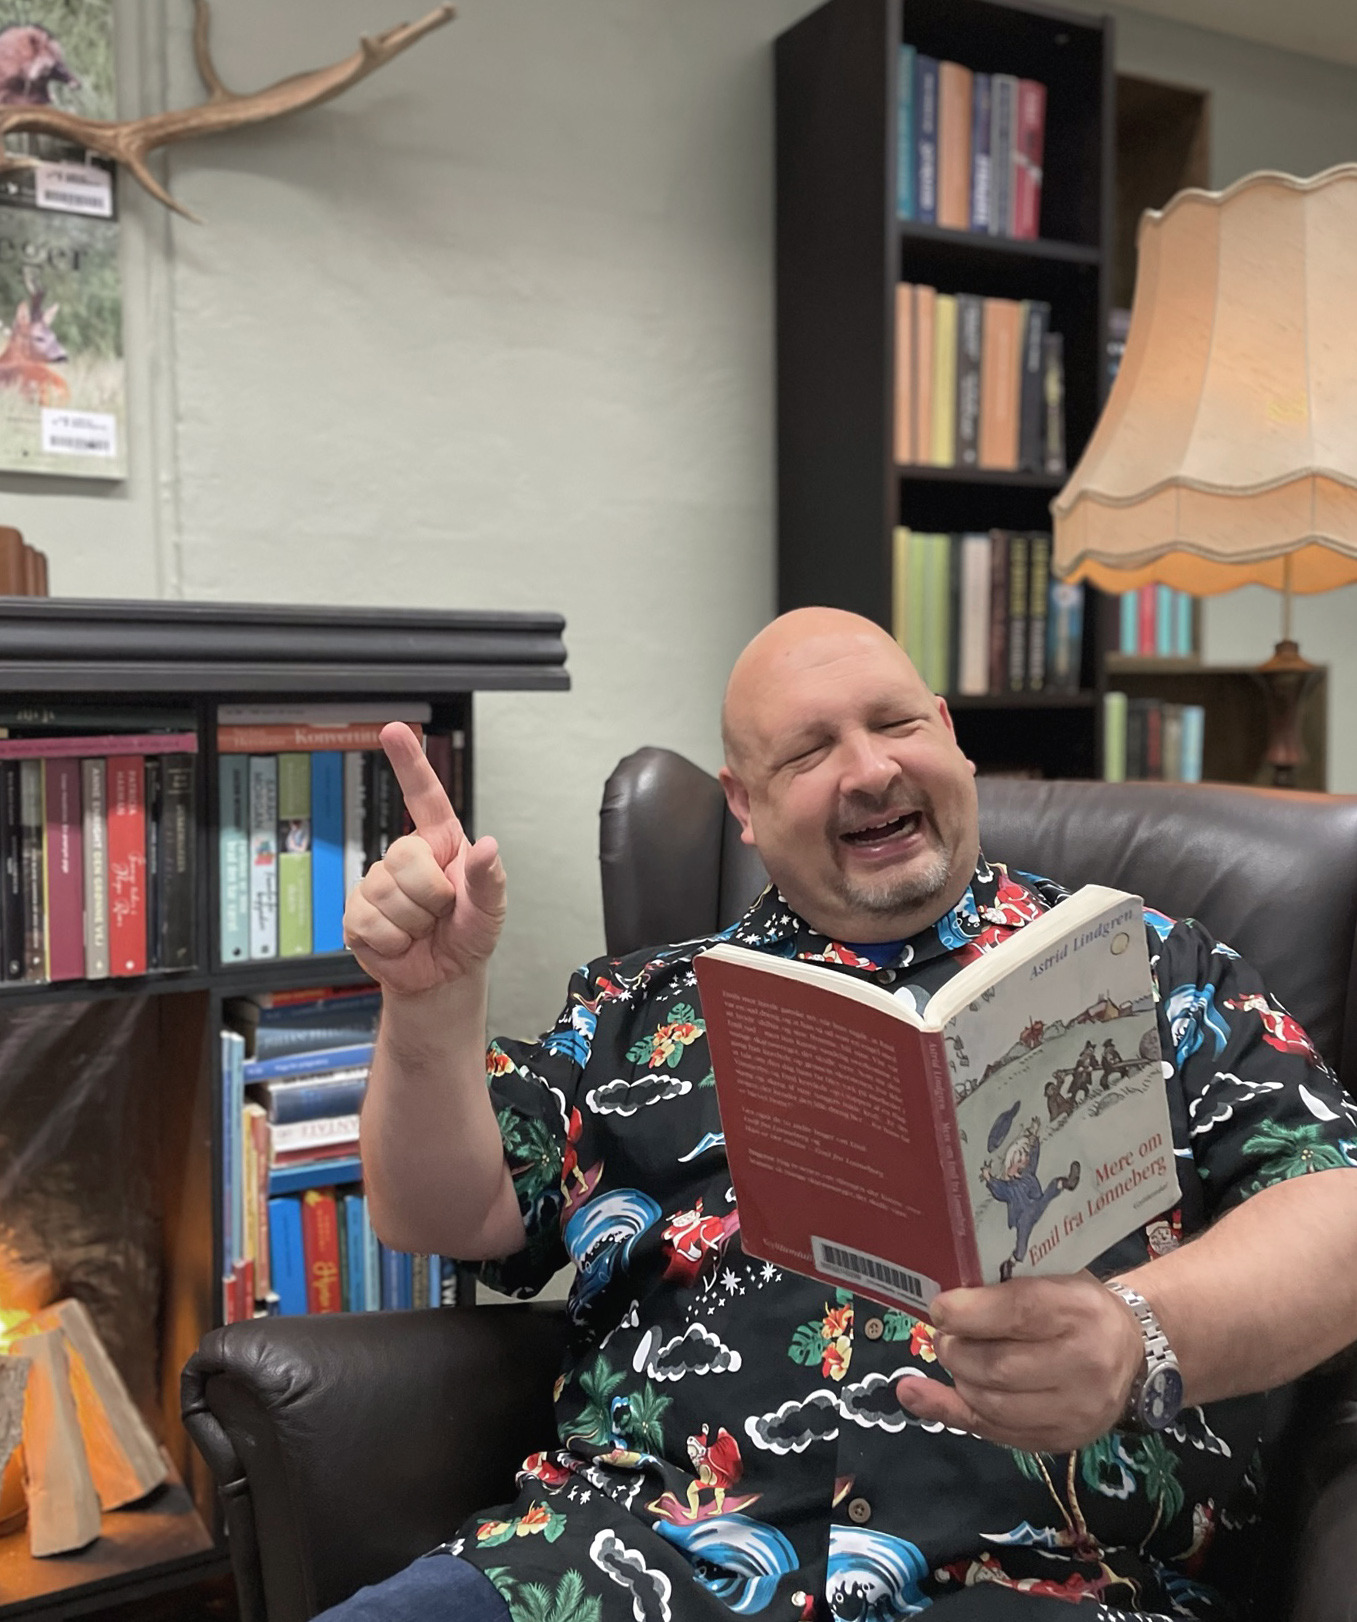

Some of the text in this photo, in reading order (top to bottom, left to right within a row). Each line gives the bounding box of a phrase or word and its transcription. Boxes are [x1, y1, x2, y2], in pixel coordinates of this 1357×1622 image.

[93, 851, 102, 875] DEN
[95, 925, 103, 946] VEJ
[1030, 909, 1133, 980] Astrid Lindgren
[929, 1042, 941, 1069] Astrid
[934, 1071, 946, 1110] Lindgren
[1095, 1132, 1163, 1186] Mere om
[1028, 1155, 1167, 1267] Emil fra Lønneberg
